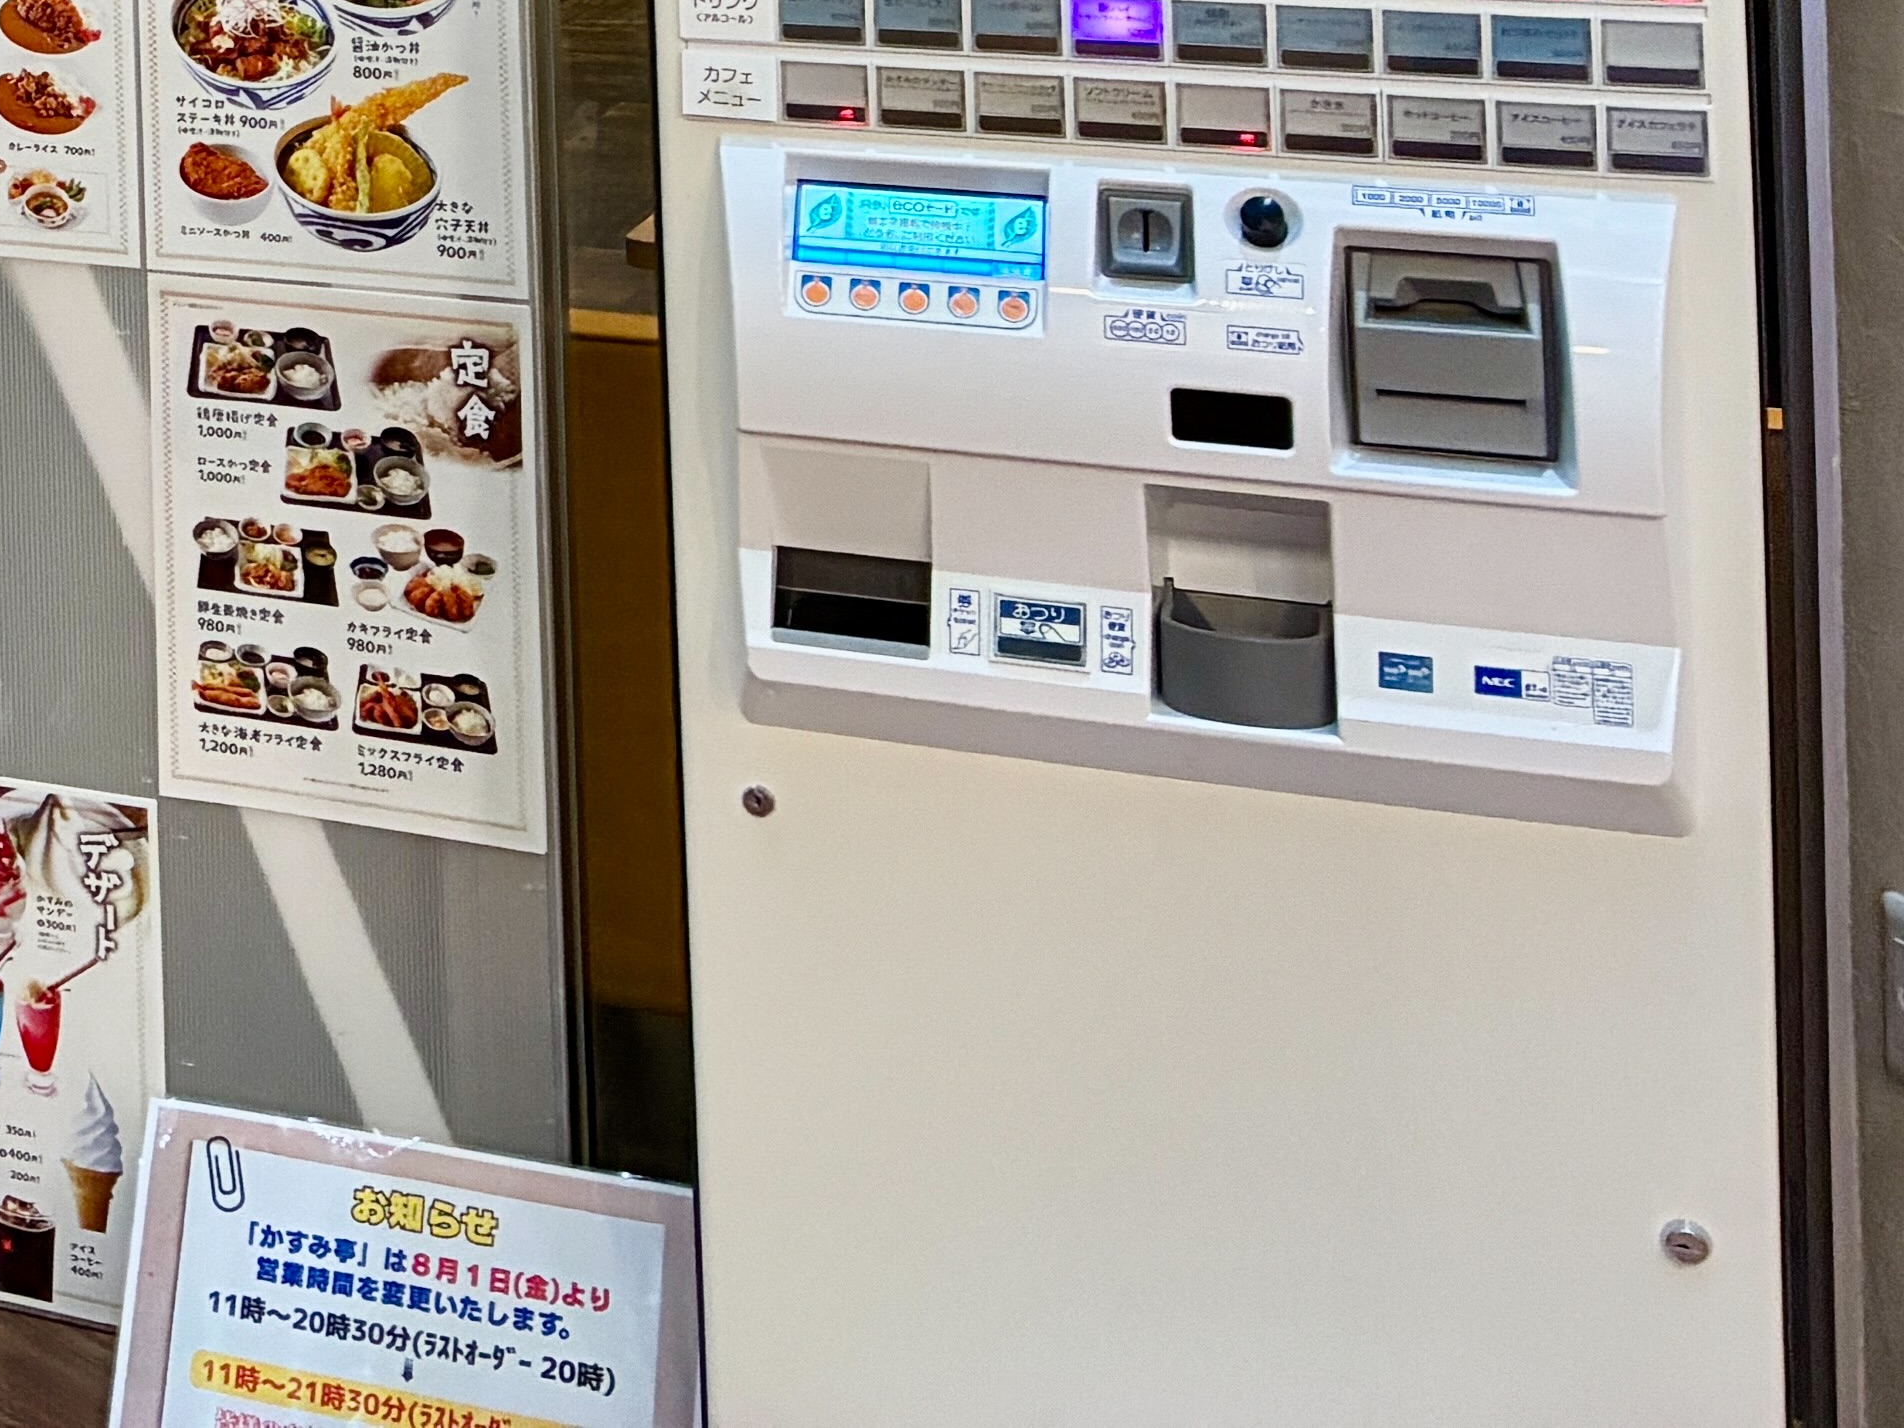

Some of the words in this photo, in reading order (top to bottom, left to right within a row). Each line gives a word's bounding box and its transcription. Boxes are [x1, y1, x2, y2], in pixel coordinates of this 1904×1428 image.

[352, 65, 393, 81] 800円
[703, 64, 754, 87] カフェ
[175, 96, 226, 110] サイコロ
[696, 87, 763, 109] メニュー
[436, 244, 478, 261] 900円
[449, 339, 497, 442] 定食
[1011, 602, 1067, 623] おつり
[197, 617, 237, 634] 980円
[346, 620, 434, 645] カキフライ定食
[346, 637, 388, 655] 980円
[1480, 674, 1517, 689] NEC
[357, 744, 466, 774] ミックスフライ定食
[78, 831, 124, 962] デザート
[350, 1184, 501, 1247] お知らせ
[254, 1254, 572, 1342] 営業時間を変更いたします。
